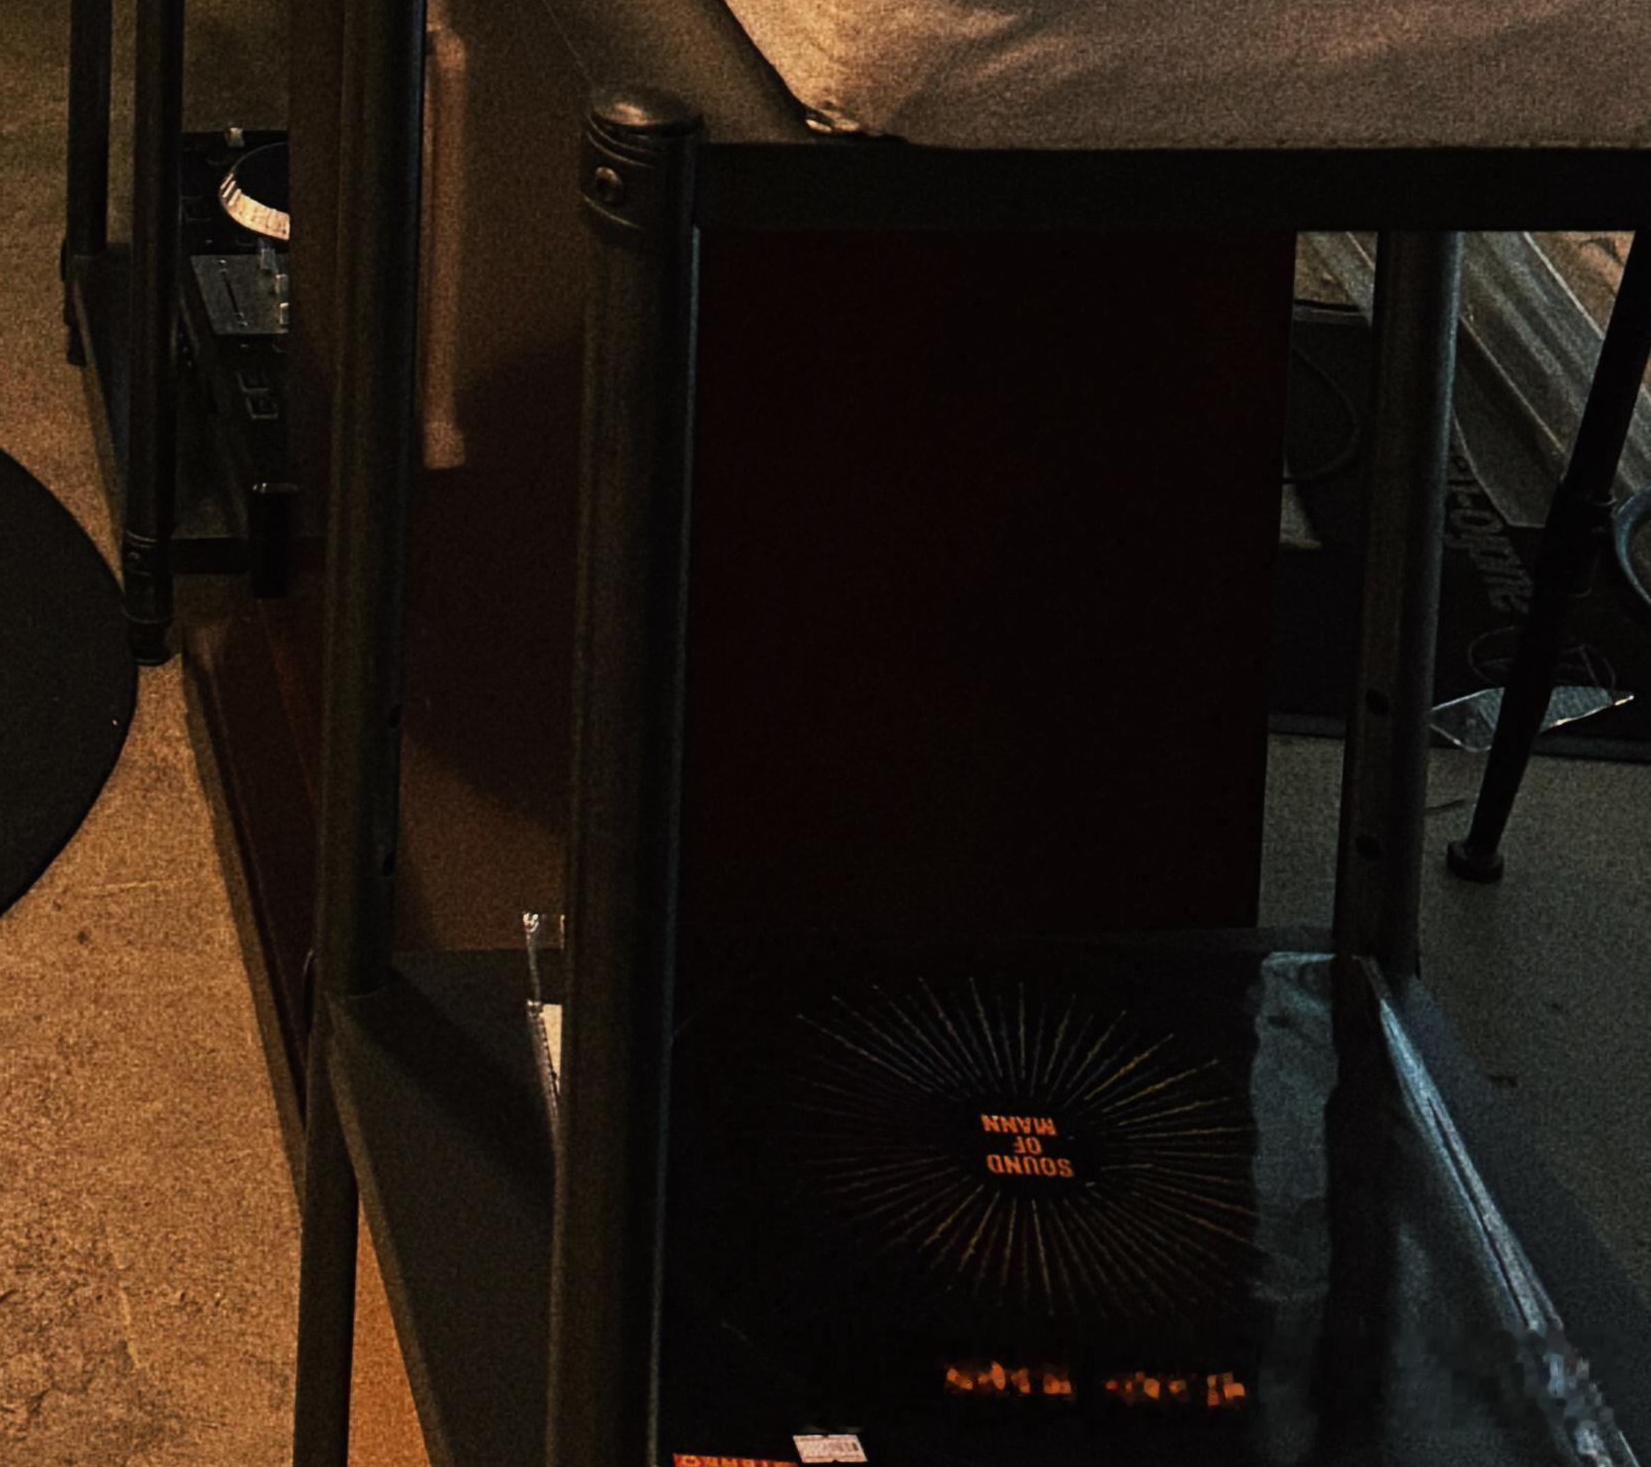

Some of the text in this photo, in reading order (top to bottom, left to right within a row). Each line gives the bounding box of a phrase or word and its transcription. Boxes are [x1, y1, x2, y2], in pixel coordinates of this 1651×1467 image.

[980, 1114, 1057, 1136] MANN
[1013, 1135, 1043, 1156] OF
[985, 1153, 1075, 1178] SOUND
